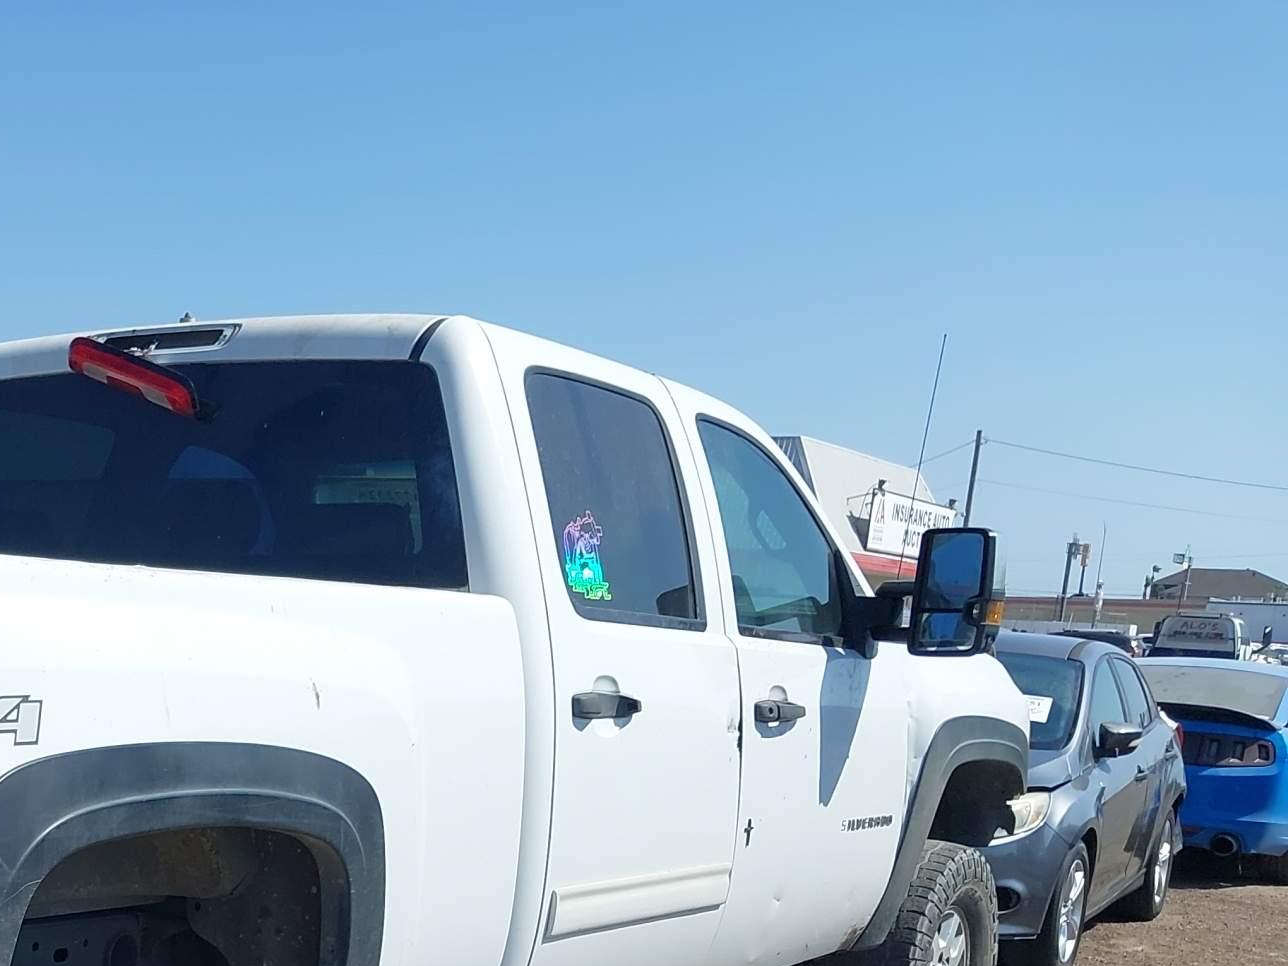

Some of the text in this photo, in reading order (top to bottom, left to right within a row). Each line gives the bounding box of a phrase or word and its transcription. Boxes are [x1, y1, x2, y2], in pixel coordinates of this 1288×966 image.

[891, 503, 951, 529] INSURANCE AUTO
[840, 814, 893, 832] SILVERADO
